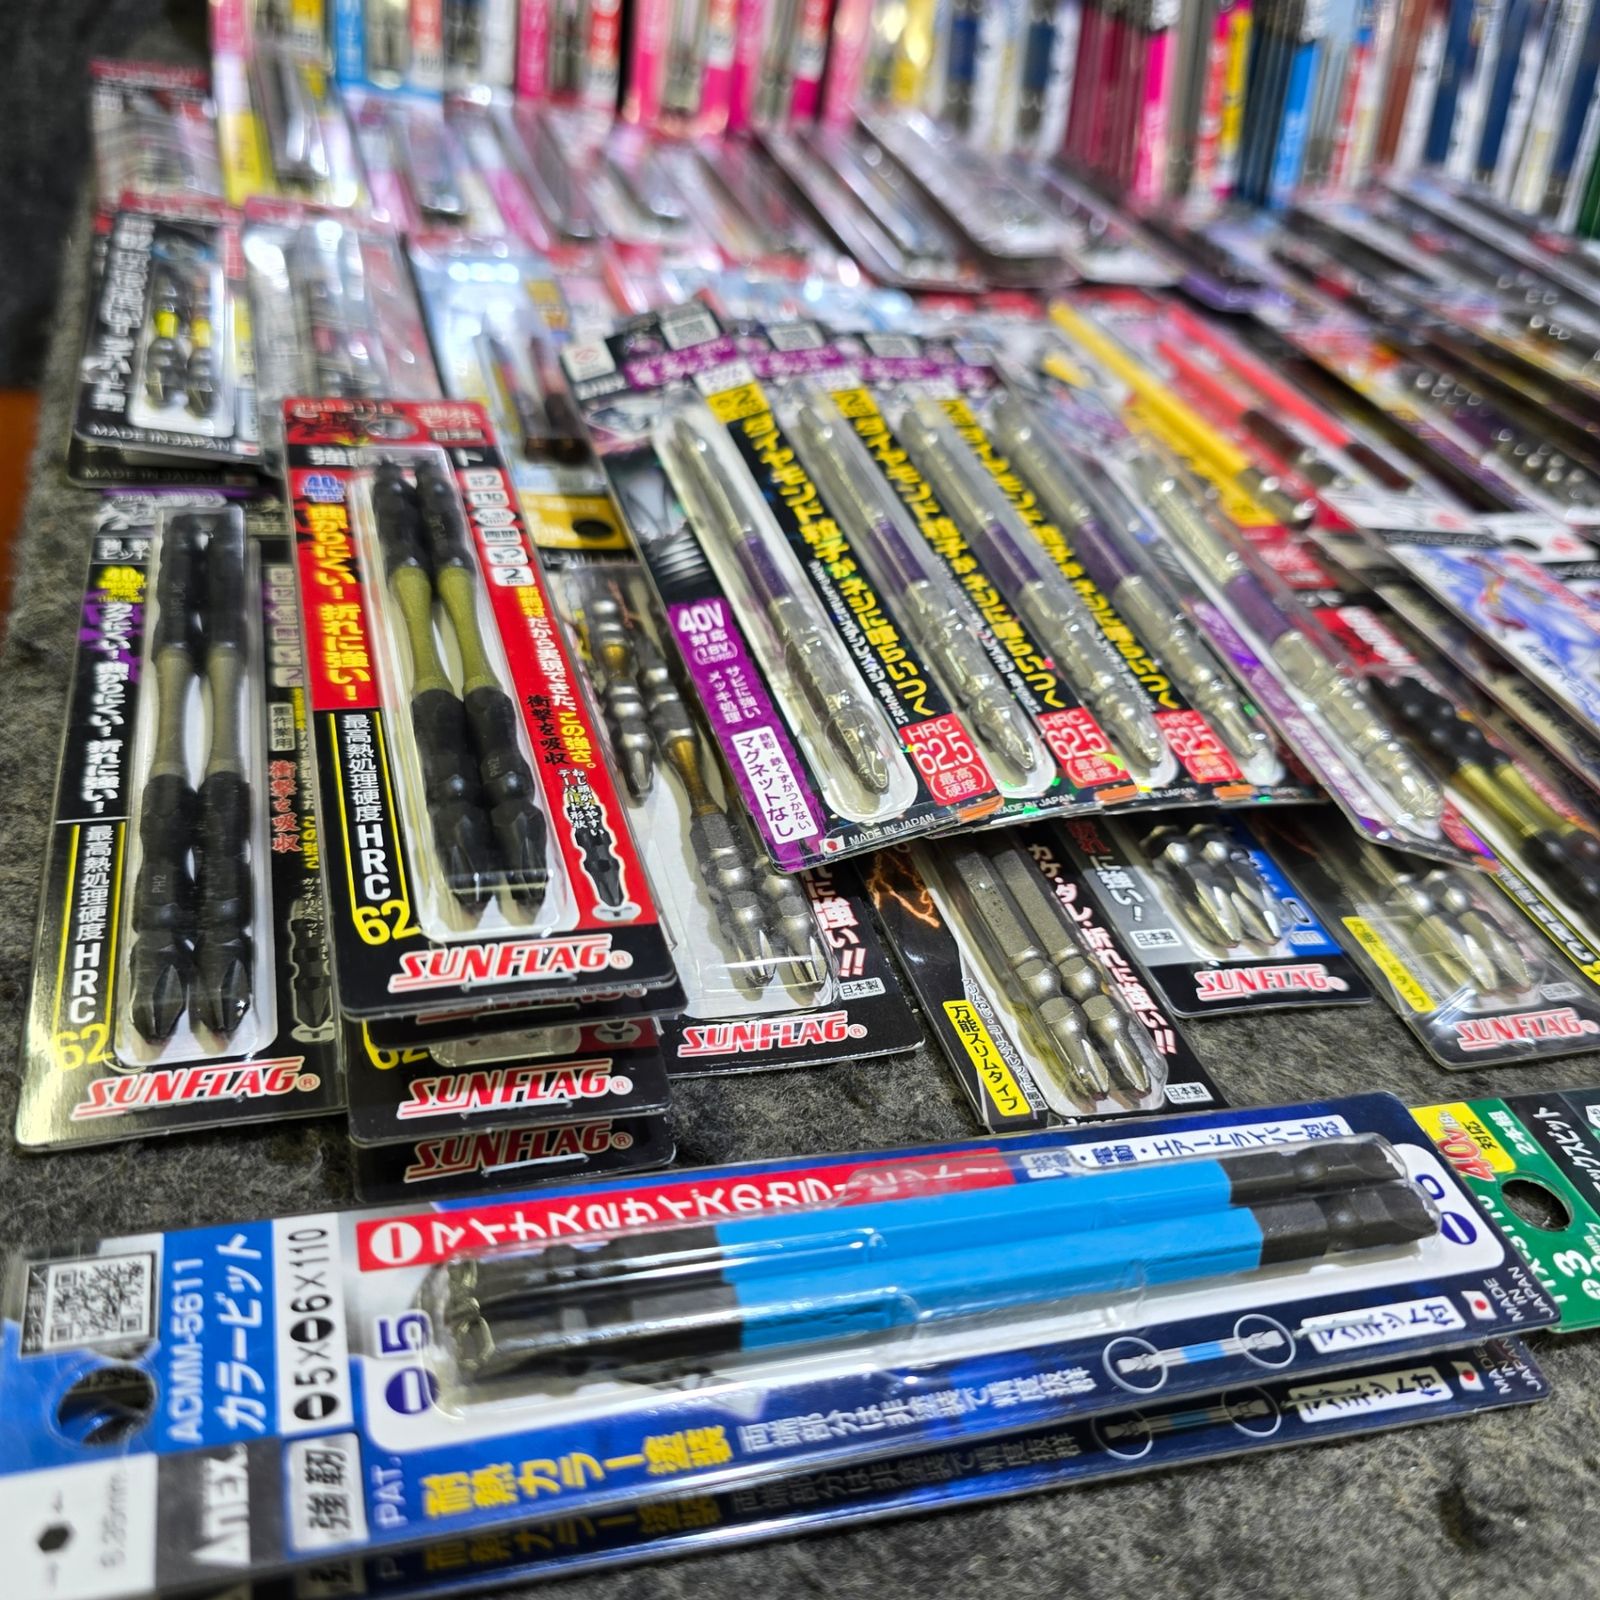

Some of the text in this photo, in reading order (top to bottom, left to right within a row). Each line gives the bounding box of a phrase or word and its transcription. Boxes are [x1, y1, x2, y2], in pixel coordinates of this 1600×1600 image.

[93, 425, 232, 451] MADE IN JAPAN
[677, 603, 726, 633] 40V
[690, 631, 729, 648] 対応
[319, 602, 371, 701] 折れに強い!
[708, 668, 744, 725] メッキ処理
[726, 664, 762, 720] サビに強い
[527, 694, 570, 765] 衝撃を吸収
[905, 718, 975, 776] HRC 62.5
[1042, 710, 1107, 762] HRC 62.5
[735, 734, 796, 838] マグネットなし
[758, 732, 812, 831] 鉄粉・鉄くずがつかない
[939, 767, 975, 789] 最高
[943, 777, 981, 799] 硬度
[1038, 792, 1076, 808] JAPAN
[267, 759, 302, 853] 衝撃を吸収
[848, 813, 936, 846] MADE IN JAPAN
[351, 898, 421, 946] 62
[1134, 931, 1180, 947] 日本製
[388, 934, 613, 993] SUNFLAG
[841, 980, 880, 995] 日本製
[1195, 963, 1330, 1001] SUNFLAG
[51, 1022, 113, 1073] 62
[677, 1010, 848, 1058] SUNFLAG
[1454, 1006, 1584, 1052] SUNFLAG
[949, 1004, 1019, 1111] 万能スリムタイプ
[70, 1056, 306, 1121] SUNFLAG
[396, 1057, 615, 1121] SUNFLAG
[1166, 1085, 1206, 1098] 日本製
[404, 1119, 614, 1183] SUNFLAG
[1436, 1128, 1497, 1182] 40V
[1461, 1119, 1496, 1150] 対応
[1487, 1109, 1540, 1156] 2本組
[1552, 1250, 1593, 1277] 3
[1483, 1277, 1525, 1323] MADE
[1507, 1265, 1555, 1318] JAPAN
[1509, 1287, 1529, 1305] IN
[166, 1257, 205, 1444] ACMM-5611
[214, 1233, 267, 1434] カラービット
[378, 1313, 433, 1358] 5
[1312, 1303, 1460, 1348] マグネット付
[738, 1365, 1098, 1456] 両端部分は非塗装で精度抜群
[371, 1456, 408, 1529] PAT.
[420, 1424, 733, 1519] 耐熱カラー塗装
